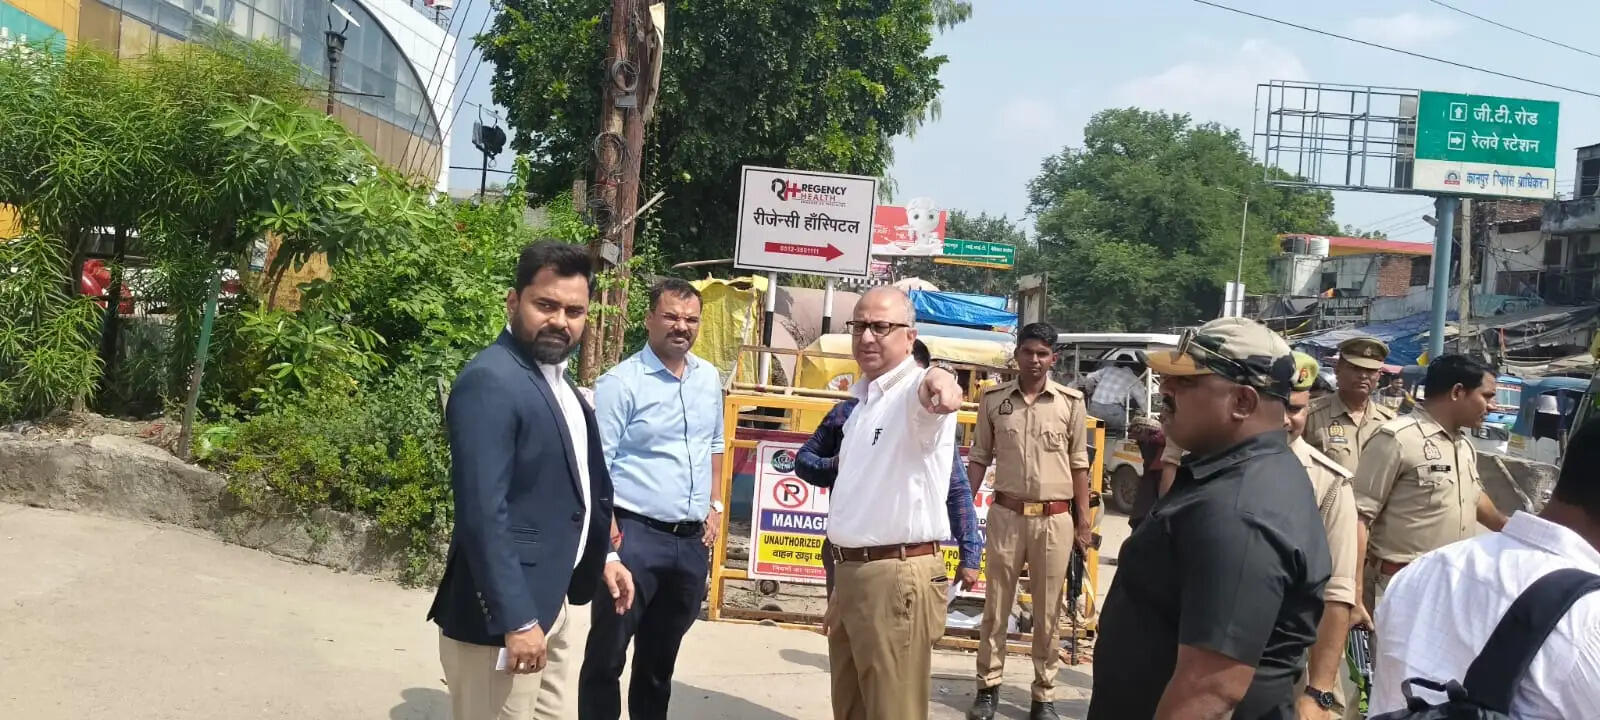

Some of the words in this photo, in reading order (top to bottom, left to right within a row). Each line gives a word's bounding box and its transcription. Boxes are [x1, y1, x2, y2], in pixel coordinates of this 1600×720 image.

[1472, 129, 1500, 150] रेलवे
[1502, 134, 1540, 153] स्टेशन
[1467, 172, 1490, 189] कानपुर
[1493, 169, 1516, 188] िकास
[801, 183, 847, 196] REGENCY
[801, 193, 836, 202] HEALTH
[753, 207, 801, 229] रीजेन्सी
[764, 534, 821, 548] UNAUTHORIZED
[772, 549, 793, 559] वाहन
[795, 551, 812, 563] खड़ा
